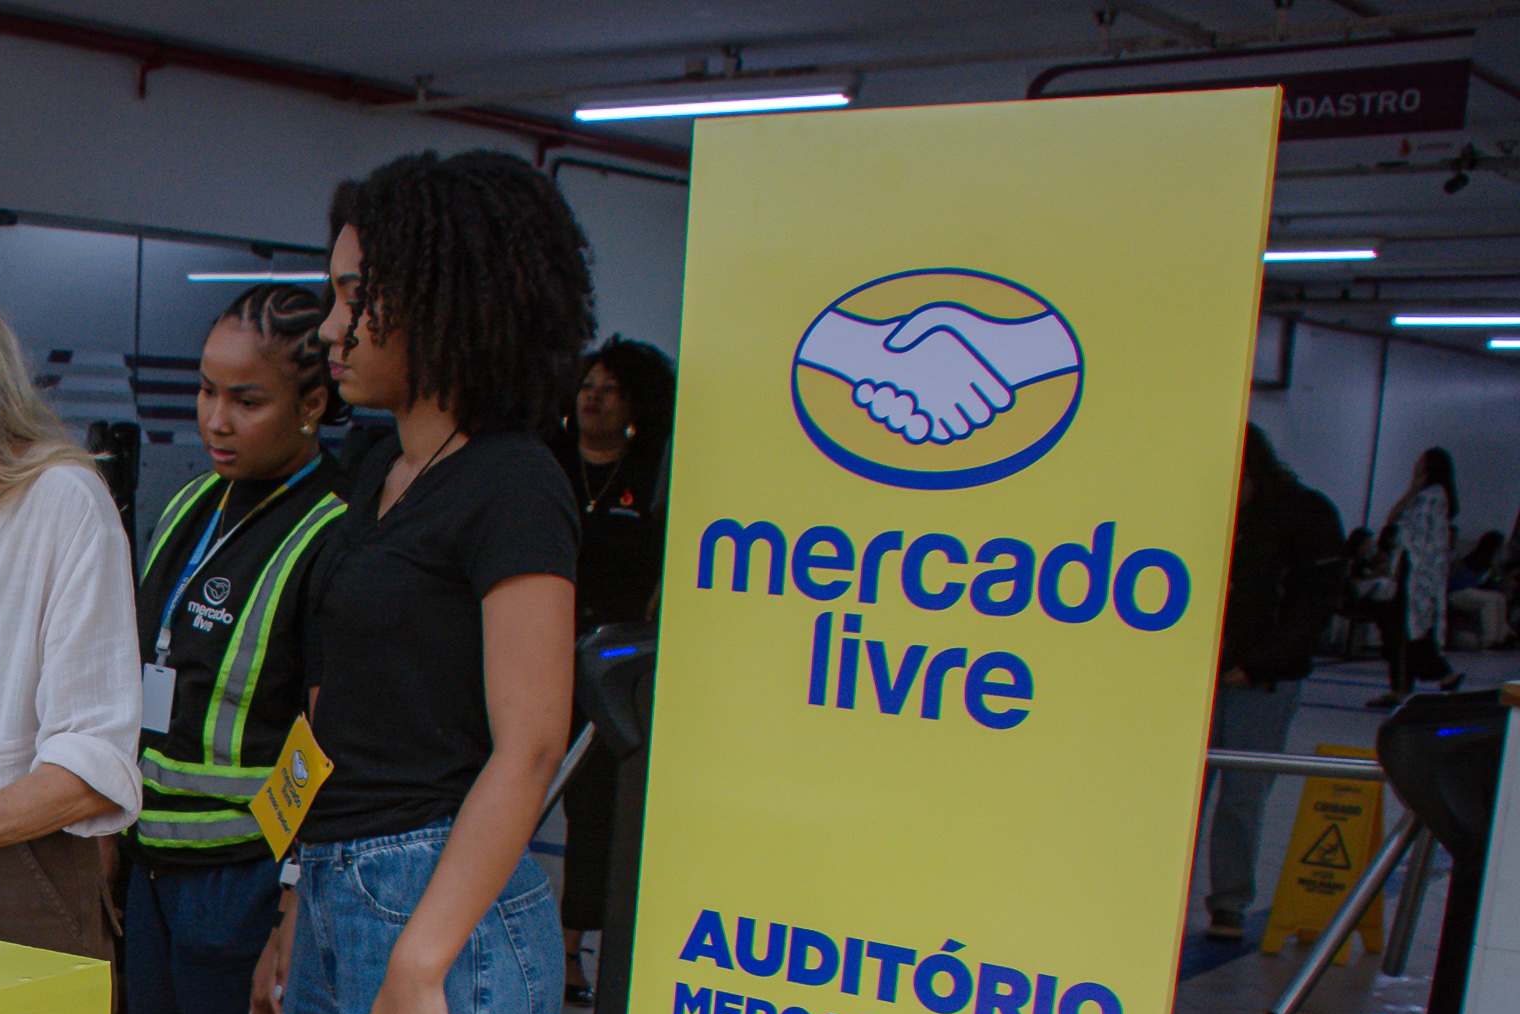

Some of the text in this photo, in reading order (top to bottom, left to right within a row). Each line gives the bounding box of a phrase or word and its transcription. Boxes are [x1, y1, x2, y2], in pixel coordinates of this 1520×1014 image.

[1281, 88, 1421, 120] ADASTRO
[697, 518, 1191, 632] mercado
[188, 601, 234, 624] mercado
[192, 614, 214, 632] livre
[809, 612, 1034, 730] livre
